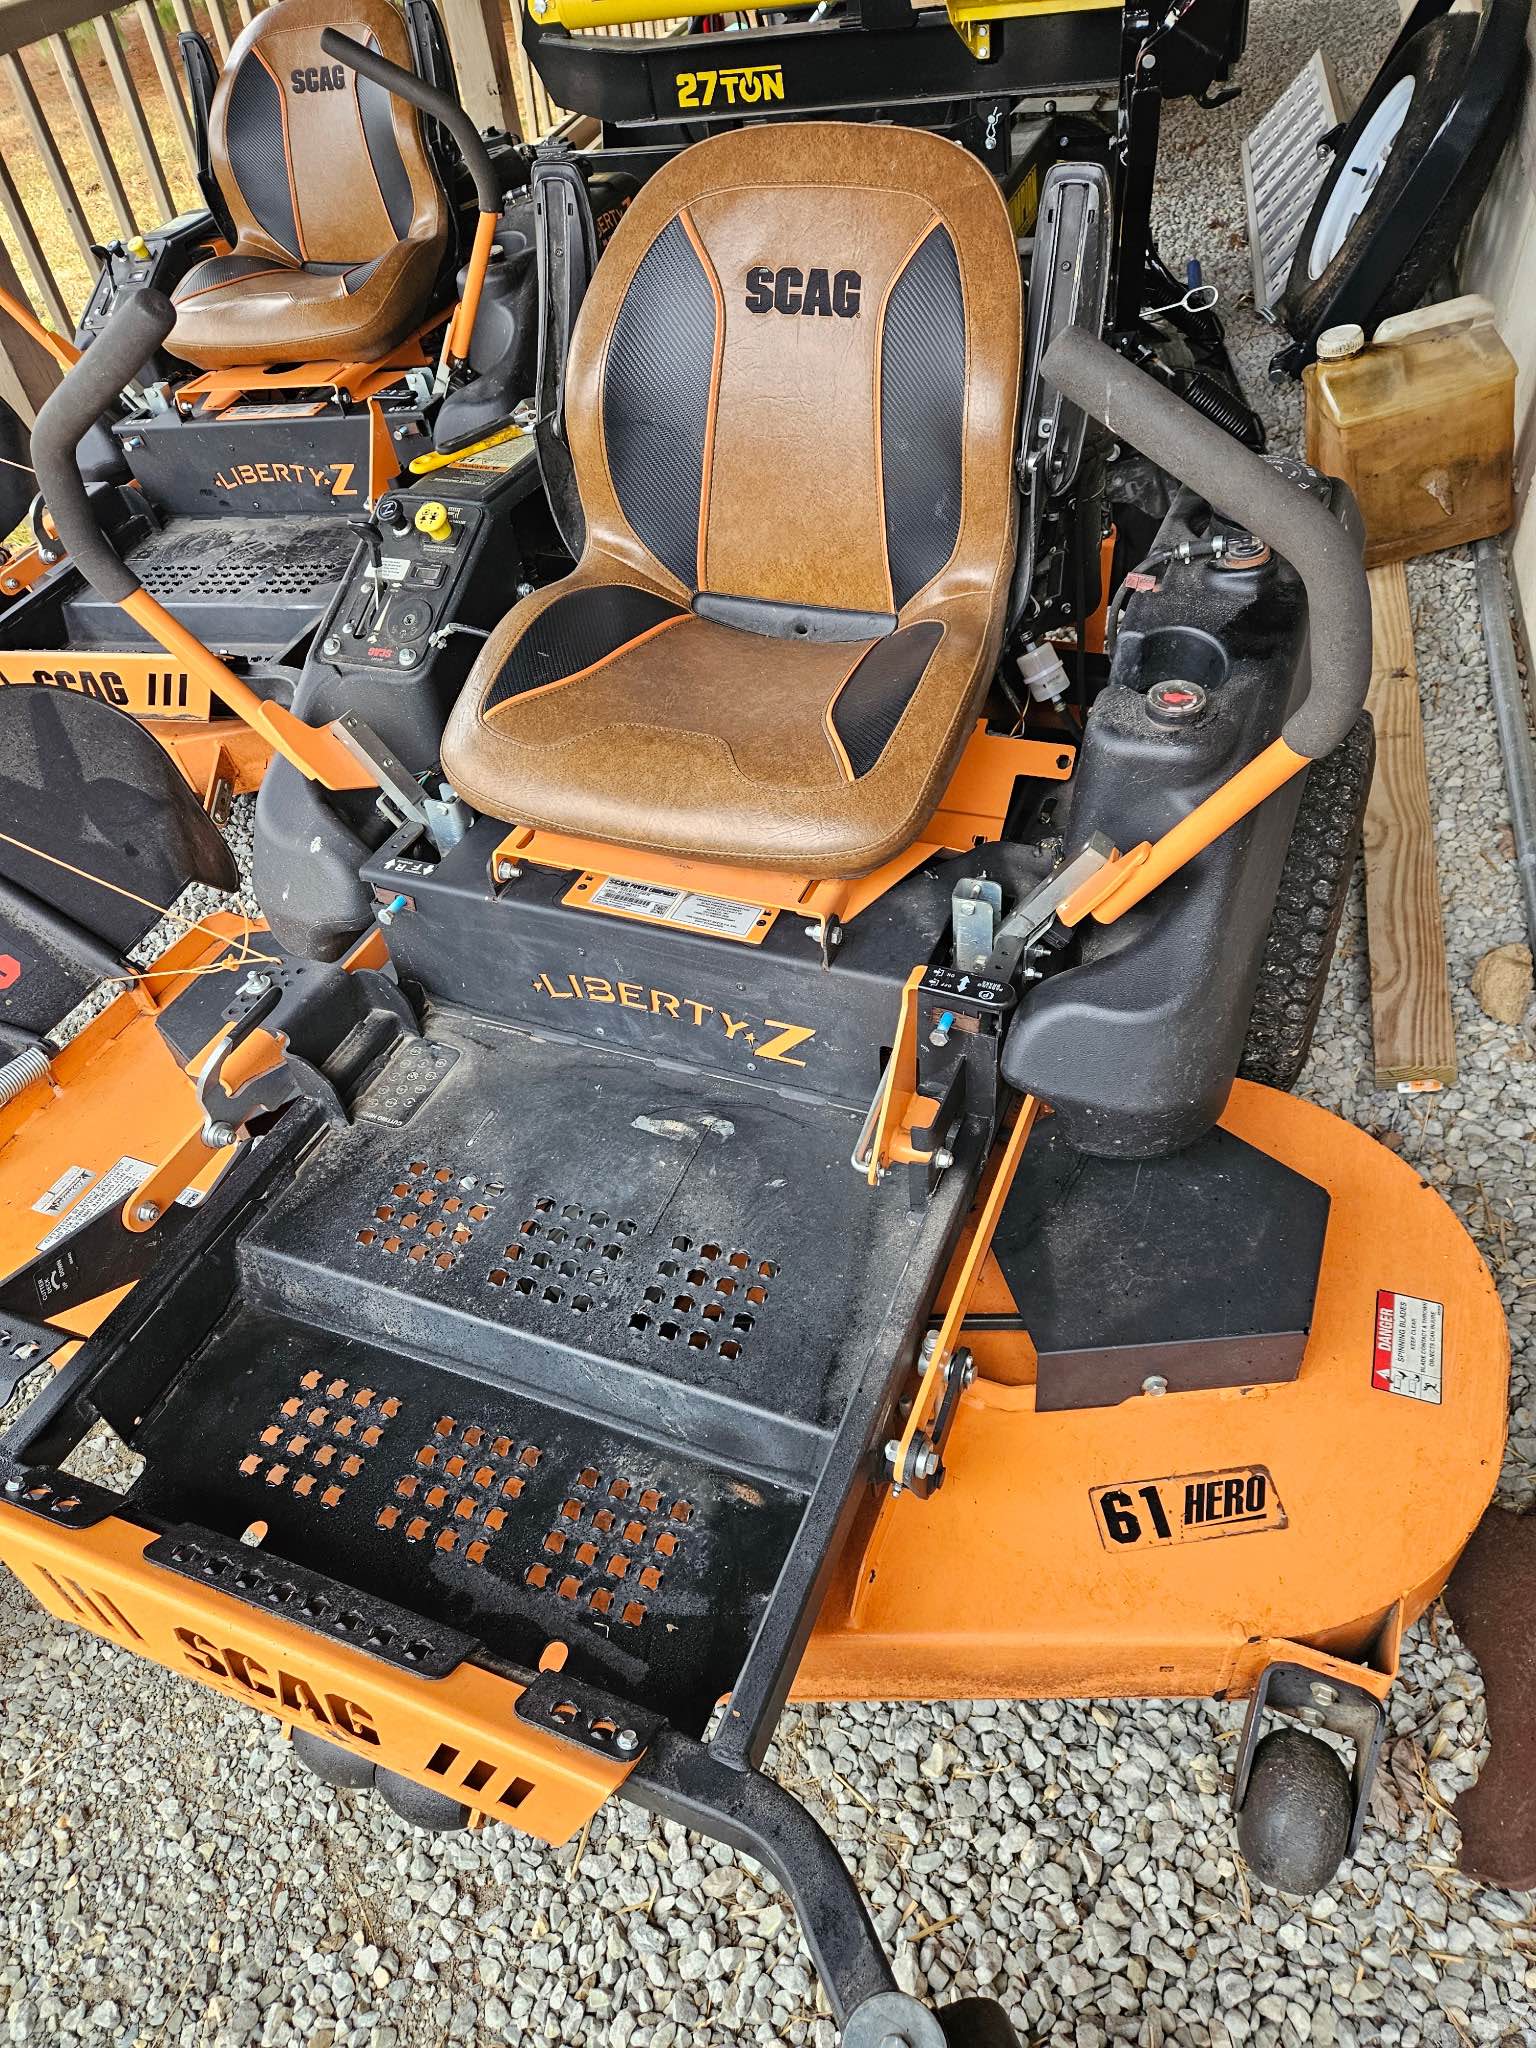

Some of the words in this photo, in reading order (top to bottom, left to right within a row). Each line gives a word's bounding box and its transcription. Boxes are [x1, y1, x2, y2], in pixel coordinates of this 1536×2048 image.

[291, 64, 346, 94] SCAG
[745, 266, 861, 318] SCAG
[216, 463, 325, 490] LIBERTY
[330, 463, 358, 496] Z
[539, 973, 750, 1040] LIBERTY
[752, 1019, 816, 1068] Z
[44, 1277, 52, 1294] DECK
[1378, 1308, 1394, 1352] DANGER
[1398, 1328, 1406, 1362] SPINNING
[1100, 1486, 1172, 1544] 61
[1184, 1475, 1267, 1526] HERO
[174, 1626, 381, 1746] SCAG
